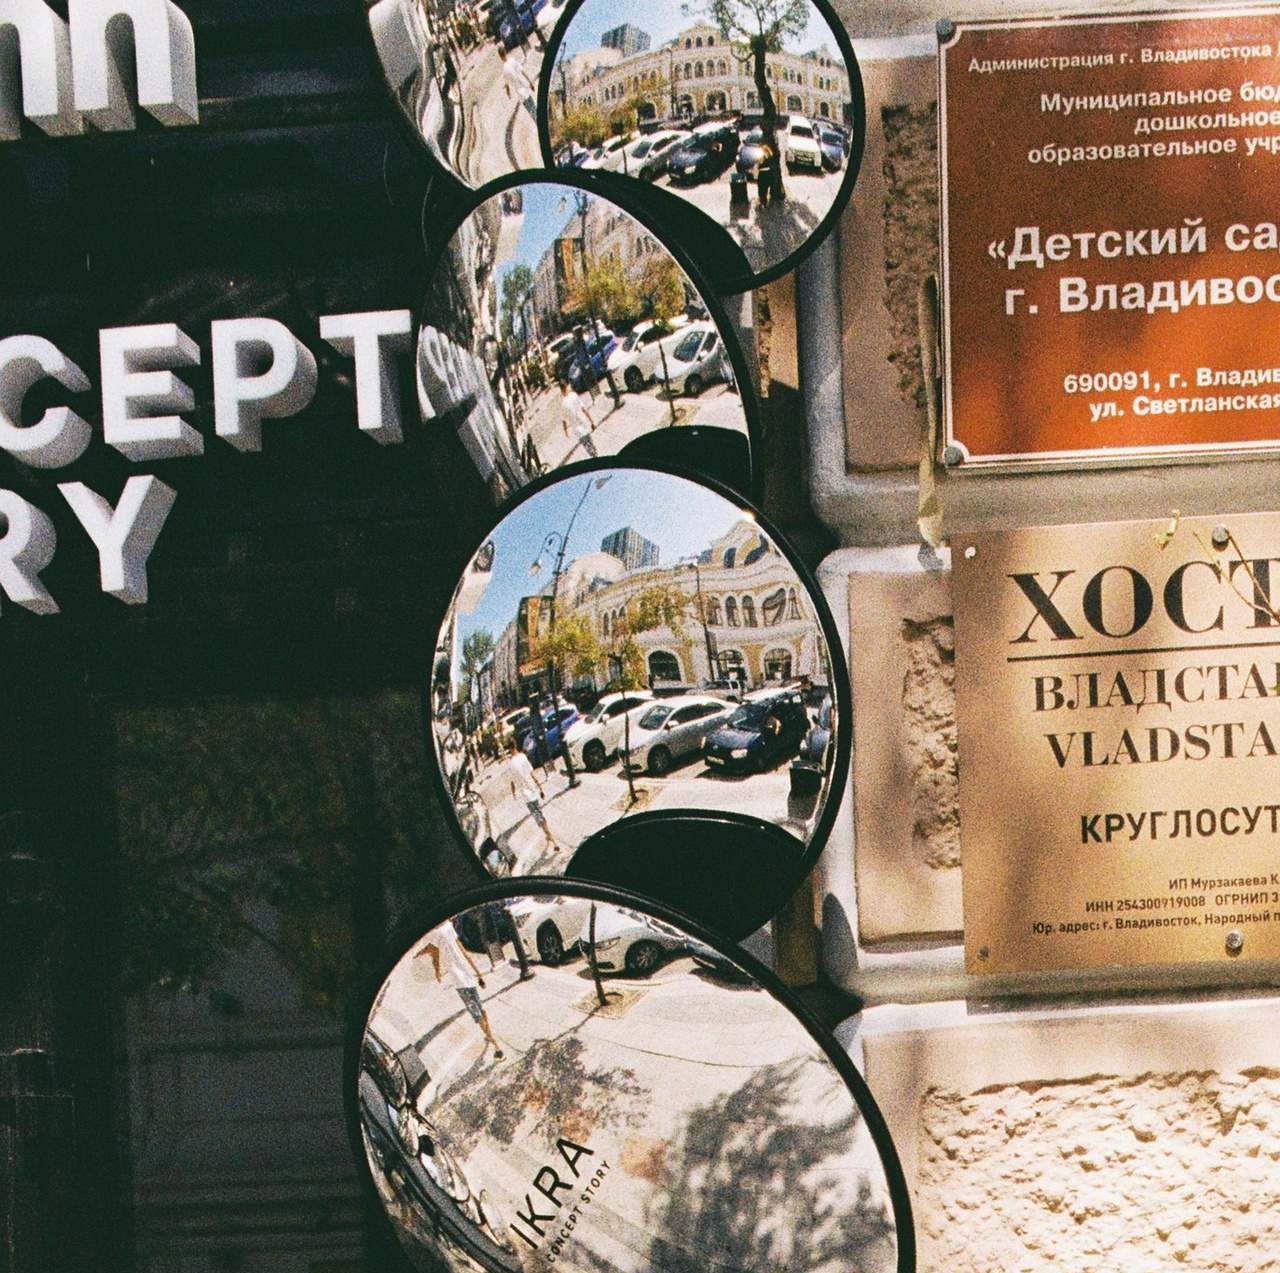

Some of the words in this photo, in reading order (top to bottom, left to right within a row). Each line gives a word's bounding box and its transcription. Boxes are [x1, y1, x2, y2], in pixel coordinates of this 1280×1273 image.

[967, 51, 1114, 73] Администрация
[1119, 54, 1134, 65] г.
[1140, 44, 1272, 64] Владивостока
[1040, 87, 1232, 115] Муниципальное
[1028, 138, 1237, 165] образовательное
[988, 217, 1207, 270] «Детский
[1005, 289, 1038, 315] г.
[0, 309, 411, 469] CEPT
[1063, 370, 1161, 394] 690091,
[1169, 372, 1188, 388] г.
[1089, 404, 1125, 423] ул.
[1169, 878, 1188, 891] ИП
[1191, 874, 1268, 891] Мурзакаева
[1085, 900, 1114, 913] ИНН
[1116, 894, 1206, 912] 254300919008
[1215, 893, 1269, 906] ОГРНИП
[1032, 922, 1057, 935] Юр.
[1059, 918, 1101, 934] адрес:
[1103, 921, 1113, 931] г.
[1115, 914, 1201, 931] Владивосток,
[1204, 908, 1271, 925] Народный
[509, 1137, 595, 1251] IKRA
[546, 1204, 583, 1264] CONCEPT
[580, 1159, 612, 1205] STORY
